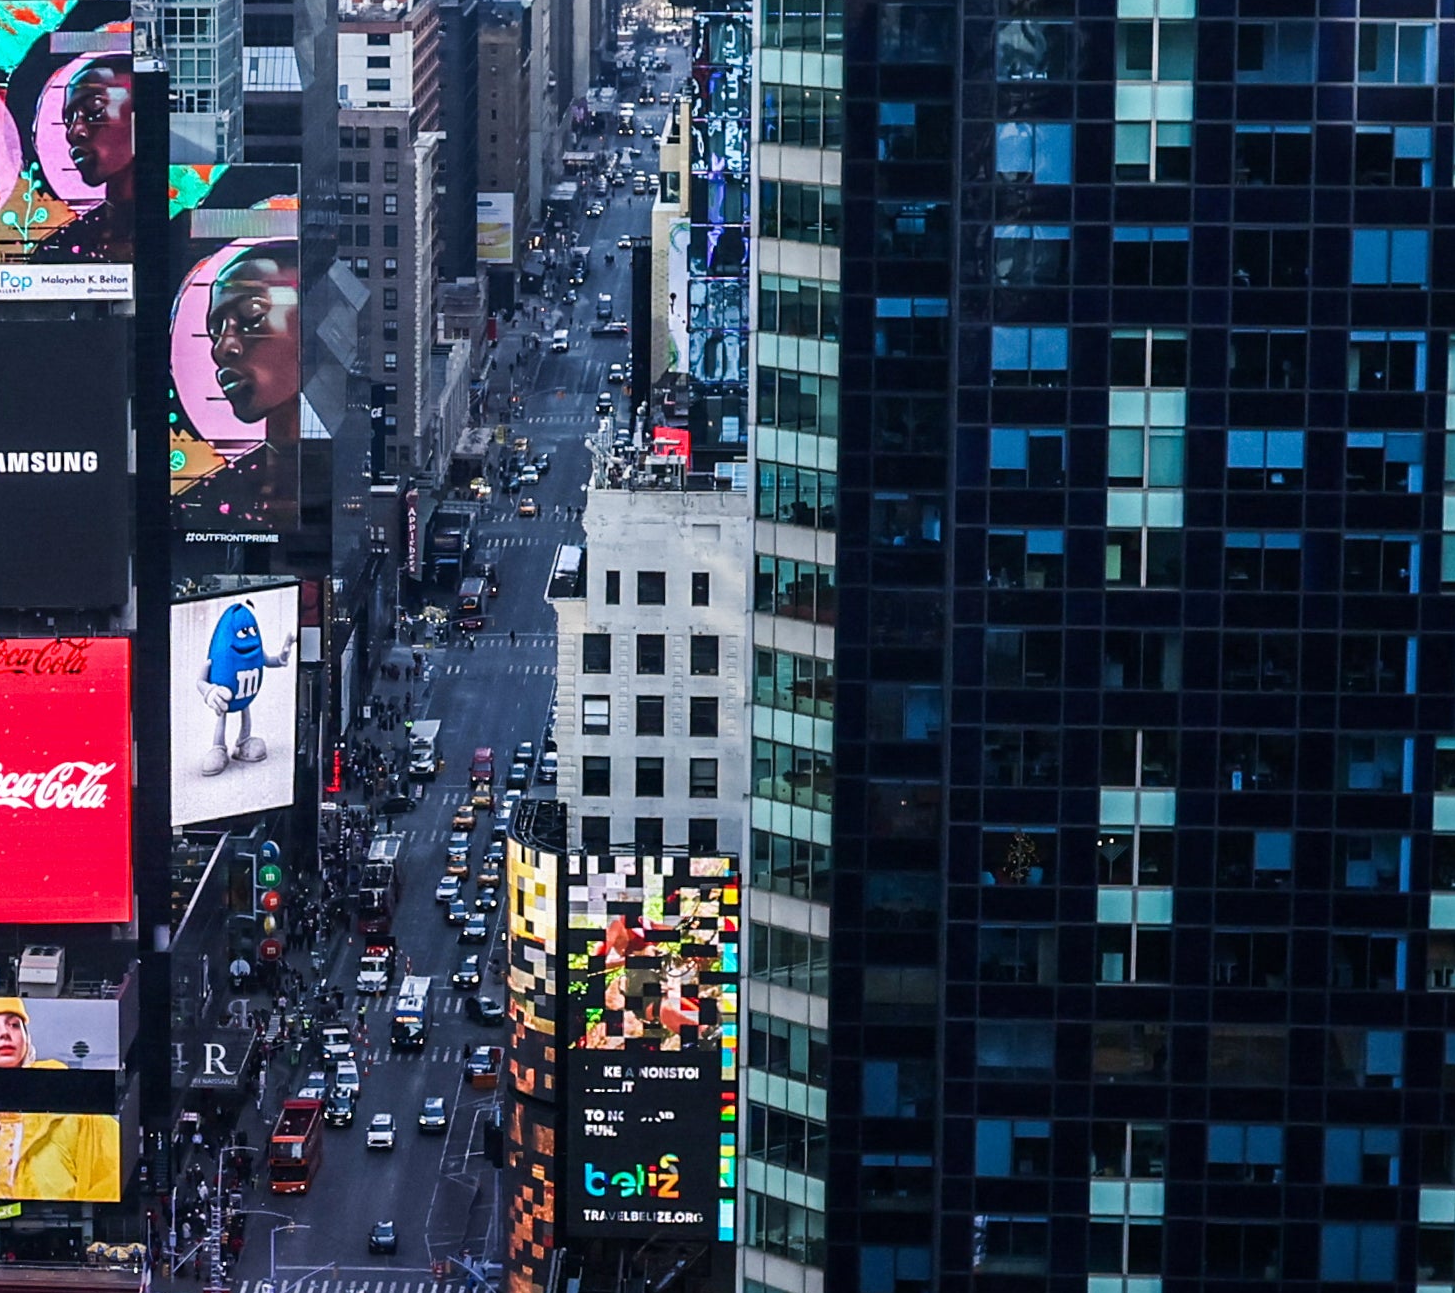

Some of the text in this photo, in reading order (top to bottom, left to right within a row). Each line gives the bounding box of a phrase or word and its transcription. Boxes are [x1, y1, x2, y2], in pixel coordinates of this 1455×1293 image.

[41, 275, 86, 286] Malaysha
[99, 275, 128, 284] Belton
[185, 532, 279, 543] #OUTFRONTPRIME
[203, 1043, 236, 1075] R
[625, 1067, 635, 1078] A
[584, 1109, 605, 1122] TO
[584, 1124, 618, 1137] FUN.
[583, 1209, 703, 1223] TRAVELBELIZE.ORG
